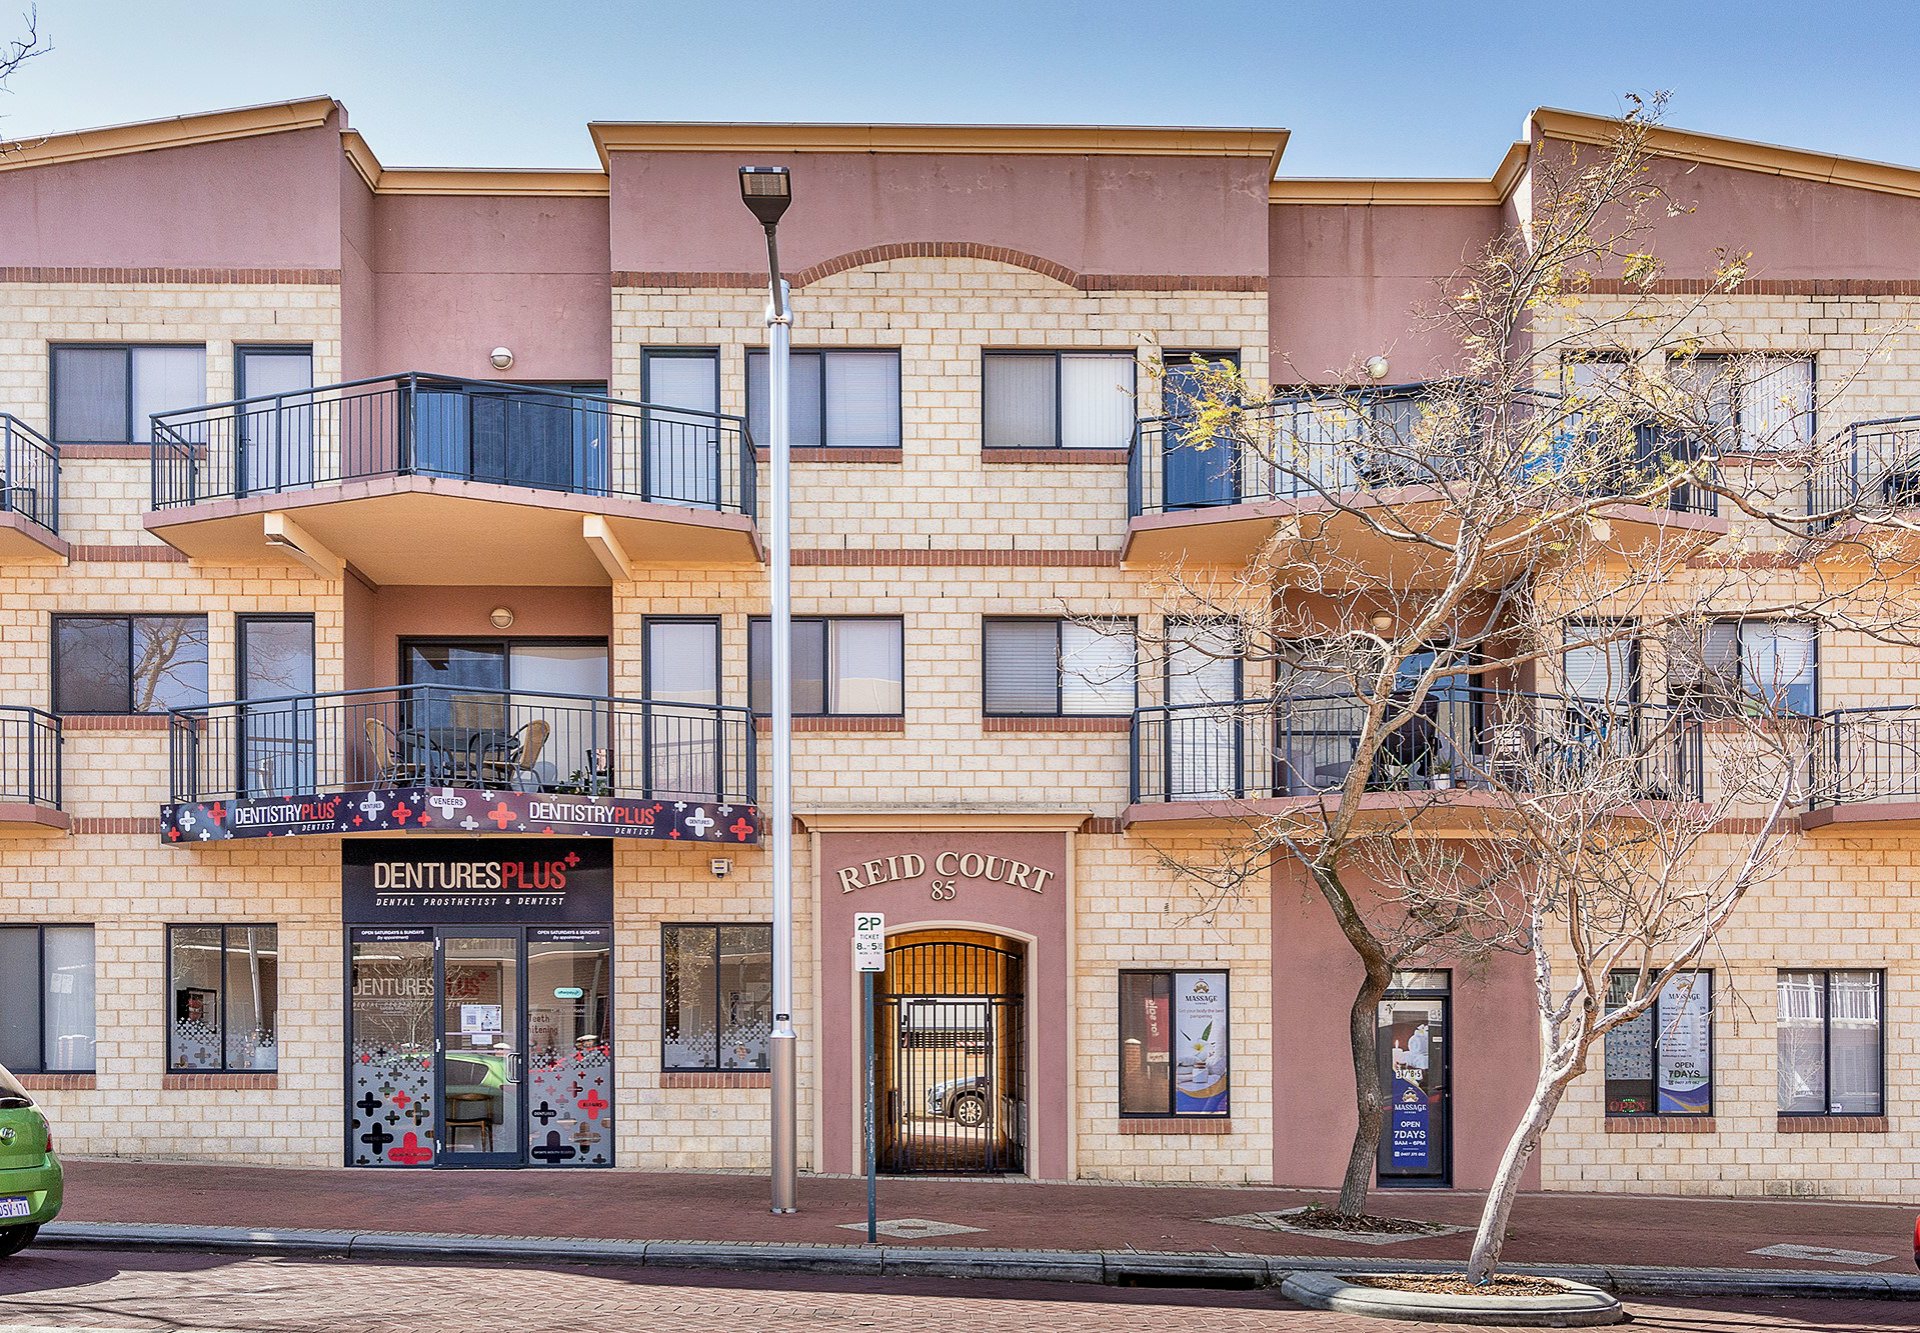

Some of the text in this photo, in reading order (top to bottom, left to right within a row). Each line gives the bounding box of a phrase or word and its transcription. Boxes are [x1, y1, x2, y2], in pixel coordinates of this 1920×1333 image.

[433, 798, 463, 806] VENEERS
[235, 802, 335, 824] DENTISTRYPLUS
[529, 802, 655, 825] DENTISTRYPLUS
[302, 823, 335, 831] DENTIST
[615, 827, 655, 836] DENTIST
[374, 862, 566, 889] DENTURESPLUS
[837, 851, 1054, 894] REID COURT
[931, 880, 956, 900] 85
[376, 898, 415, 906] DENTAL
[423, 898, 497, 906] PROSTHETIST
[518, 897, 564, 905] DENTIST
[858, 917, 881, 931] 2P
[1185, 995, 1218, 1003] MASSAGE
[528, 1013, 550, 1022] Teeth
[529, 1026, 558, 1036] itening
[1668, 1070, 1701, 1078] 7DAYS
[1394, 1104, 1427, 1112] MASSAGE
[1394, 1130, 1426, 1139] 7DAYS
